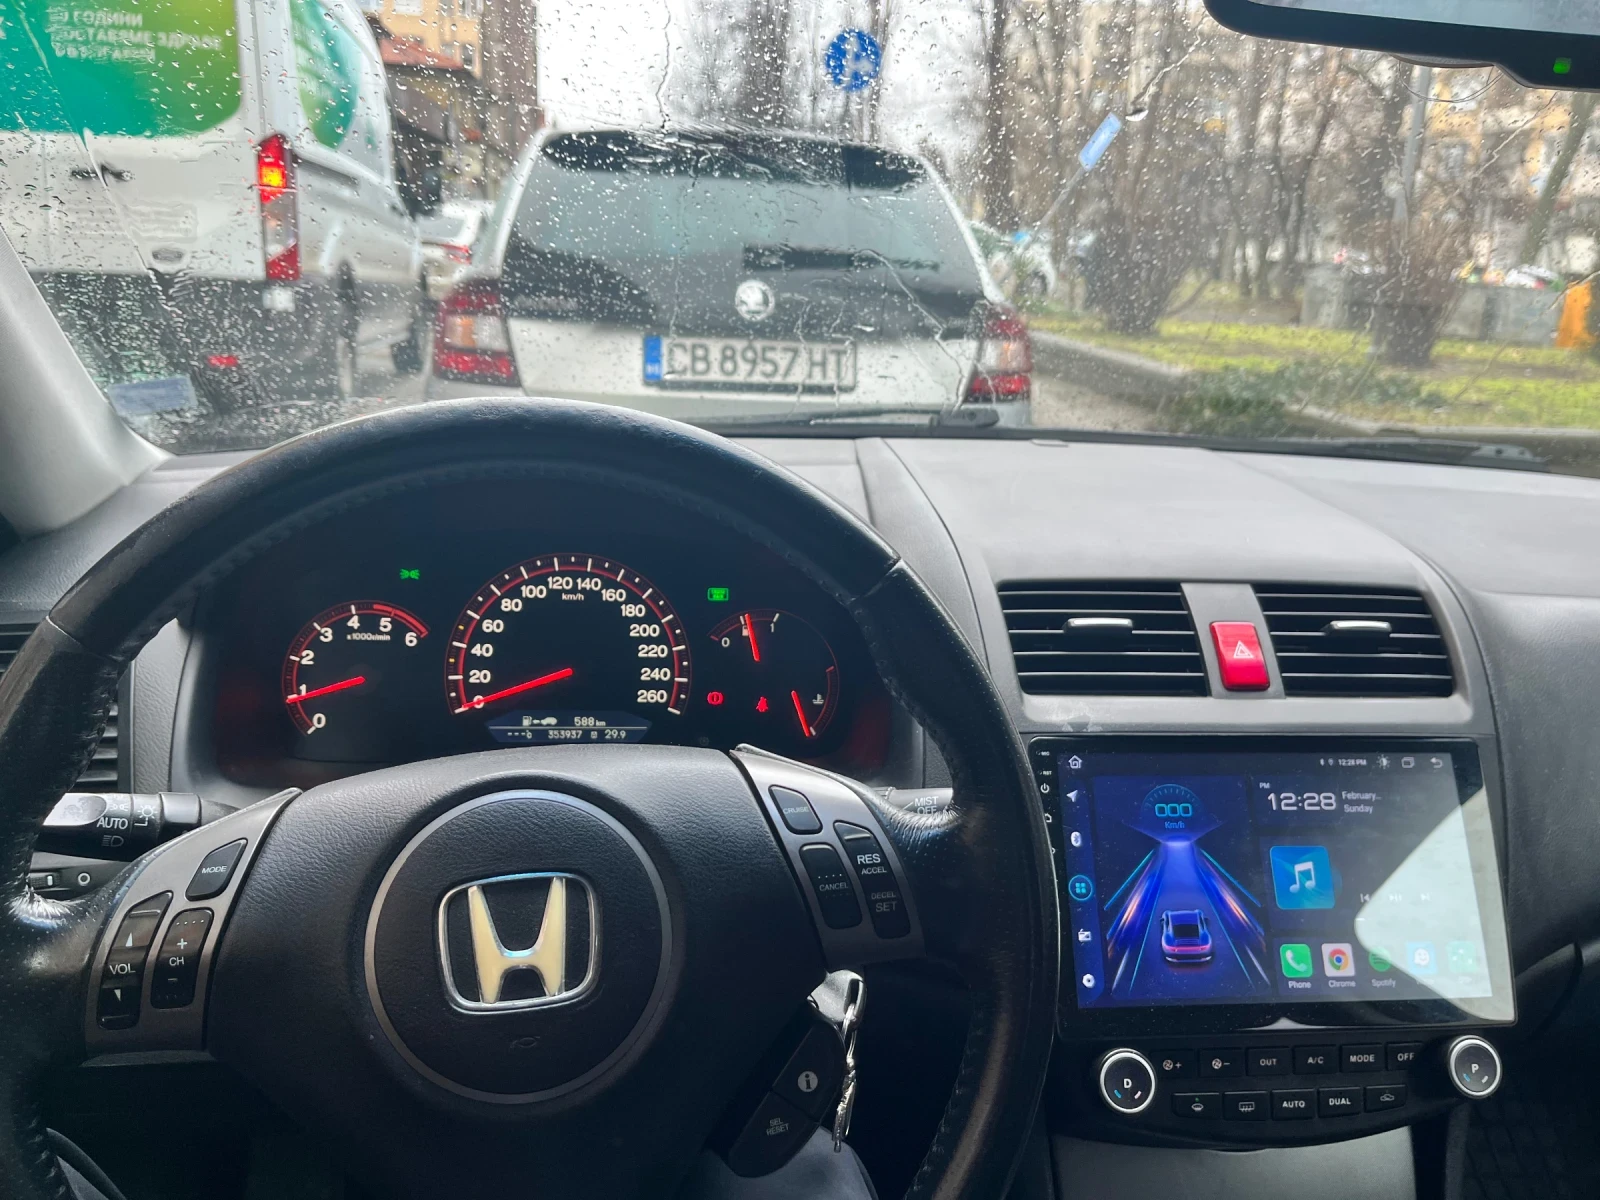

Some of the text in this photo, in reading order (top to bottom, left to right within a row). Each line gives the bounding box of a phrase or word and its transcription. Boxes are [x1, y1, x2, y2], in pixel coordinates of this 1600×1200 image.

[669, 343, 711, 376] CB
[720, 344, 799, 379] 8957
[547, 576, 573, 590] 120
[576, 577, 602, 591] 140
[520, 584, 547, 598] 100
[561, 592, 584, 601] km/h
[601, 588, 627, 602] 160
[500, 598, 522, 612] 80
[620, 603, 646, 618] 180
[347, 616, 360, 630] 4
[379, 617, 392, 632] 5
[481, 619, 504, 634] 60
[319, 628, 333, 642] 3
[629, 624, 660, 638] 200
[405, 632, 418, 647] 6
[721, 637, 730, 648] 0
[470, 643, 494, 658] 40
[637, 644, 668, 658] 220
[301, 650, 315, 665] 2
[469, 669, 491, 684] 20
[640, 667, 671, 681] 240
[637, 689, 668, 703] 260
[312, 713, 327, 728] 0
[574, 716, 595, 727] 588
[547, 729, 583, 740] 353937
[604, 729, 627, 740] 29.9
[915, 796, 939, 807] MIST
[1267, 792, 1337, 811] 12:28
[783, 806, 810, 815] CRUISE
[1344, 803, 1374, 814] Sunday
[97, 817, 128, 830] AUTO
[857, 853, 881, 865] RES
[202, 865, 227, 874] MODE
[861, 866, 887, 875] ACCEL
[819, 882, 848, 892] CANCEL
[871, 891, 896, 900] DECEL
[876, 901, 897, 913] SET
[169, 956, 185, 967] CH
[109, 963, 136, 976] VOL
[1288, 980, 1311, 989] Phone
[1328, 979, 1356, 989] Chrome
[1371, 978, 1396, 988] Spotify
[1259, 1058, 1277, 1067] OUT
[1307, 1055, 1324, 1065] A/C
[1350, 1053, 1375, 1063] MODE
[1397, 1052, 1415, 1061] OFF
[1471, 1063, 1479, 1073] P
[1123, 1078, 1132, 1089] D
[1282, 1100, 1306, 1109] AUTO
[1328, 1097, 1352, 1106] DUAL
[769, 1118, 783, 1127] SEL
[766, 1123, 789, 1135] RESET
